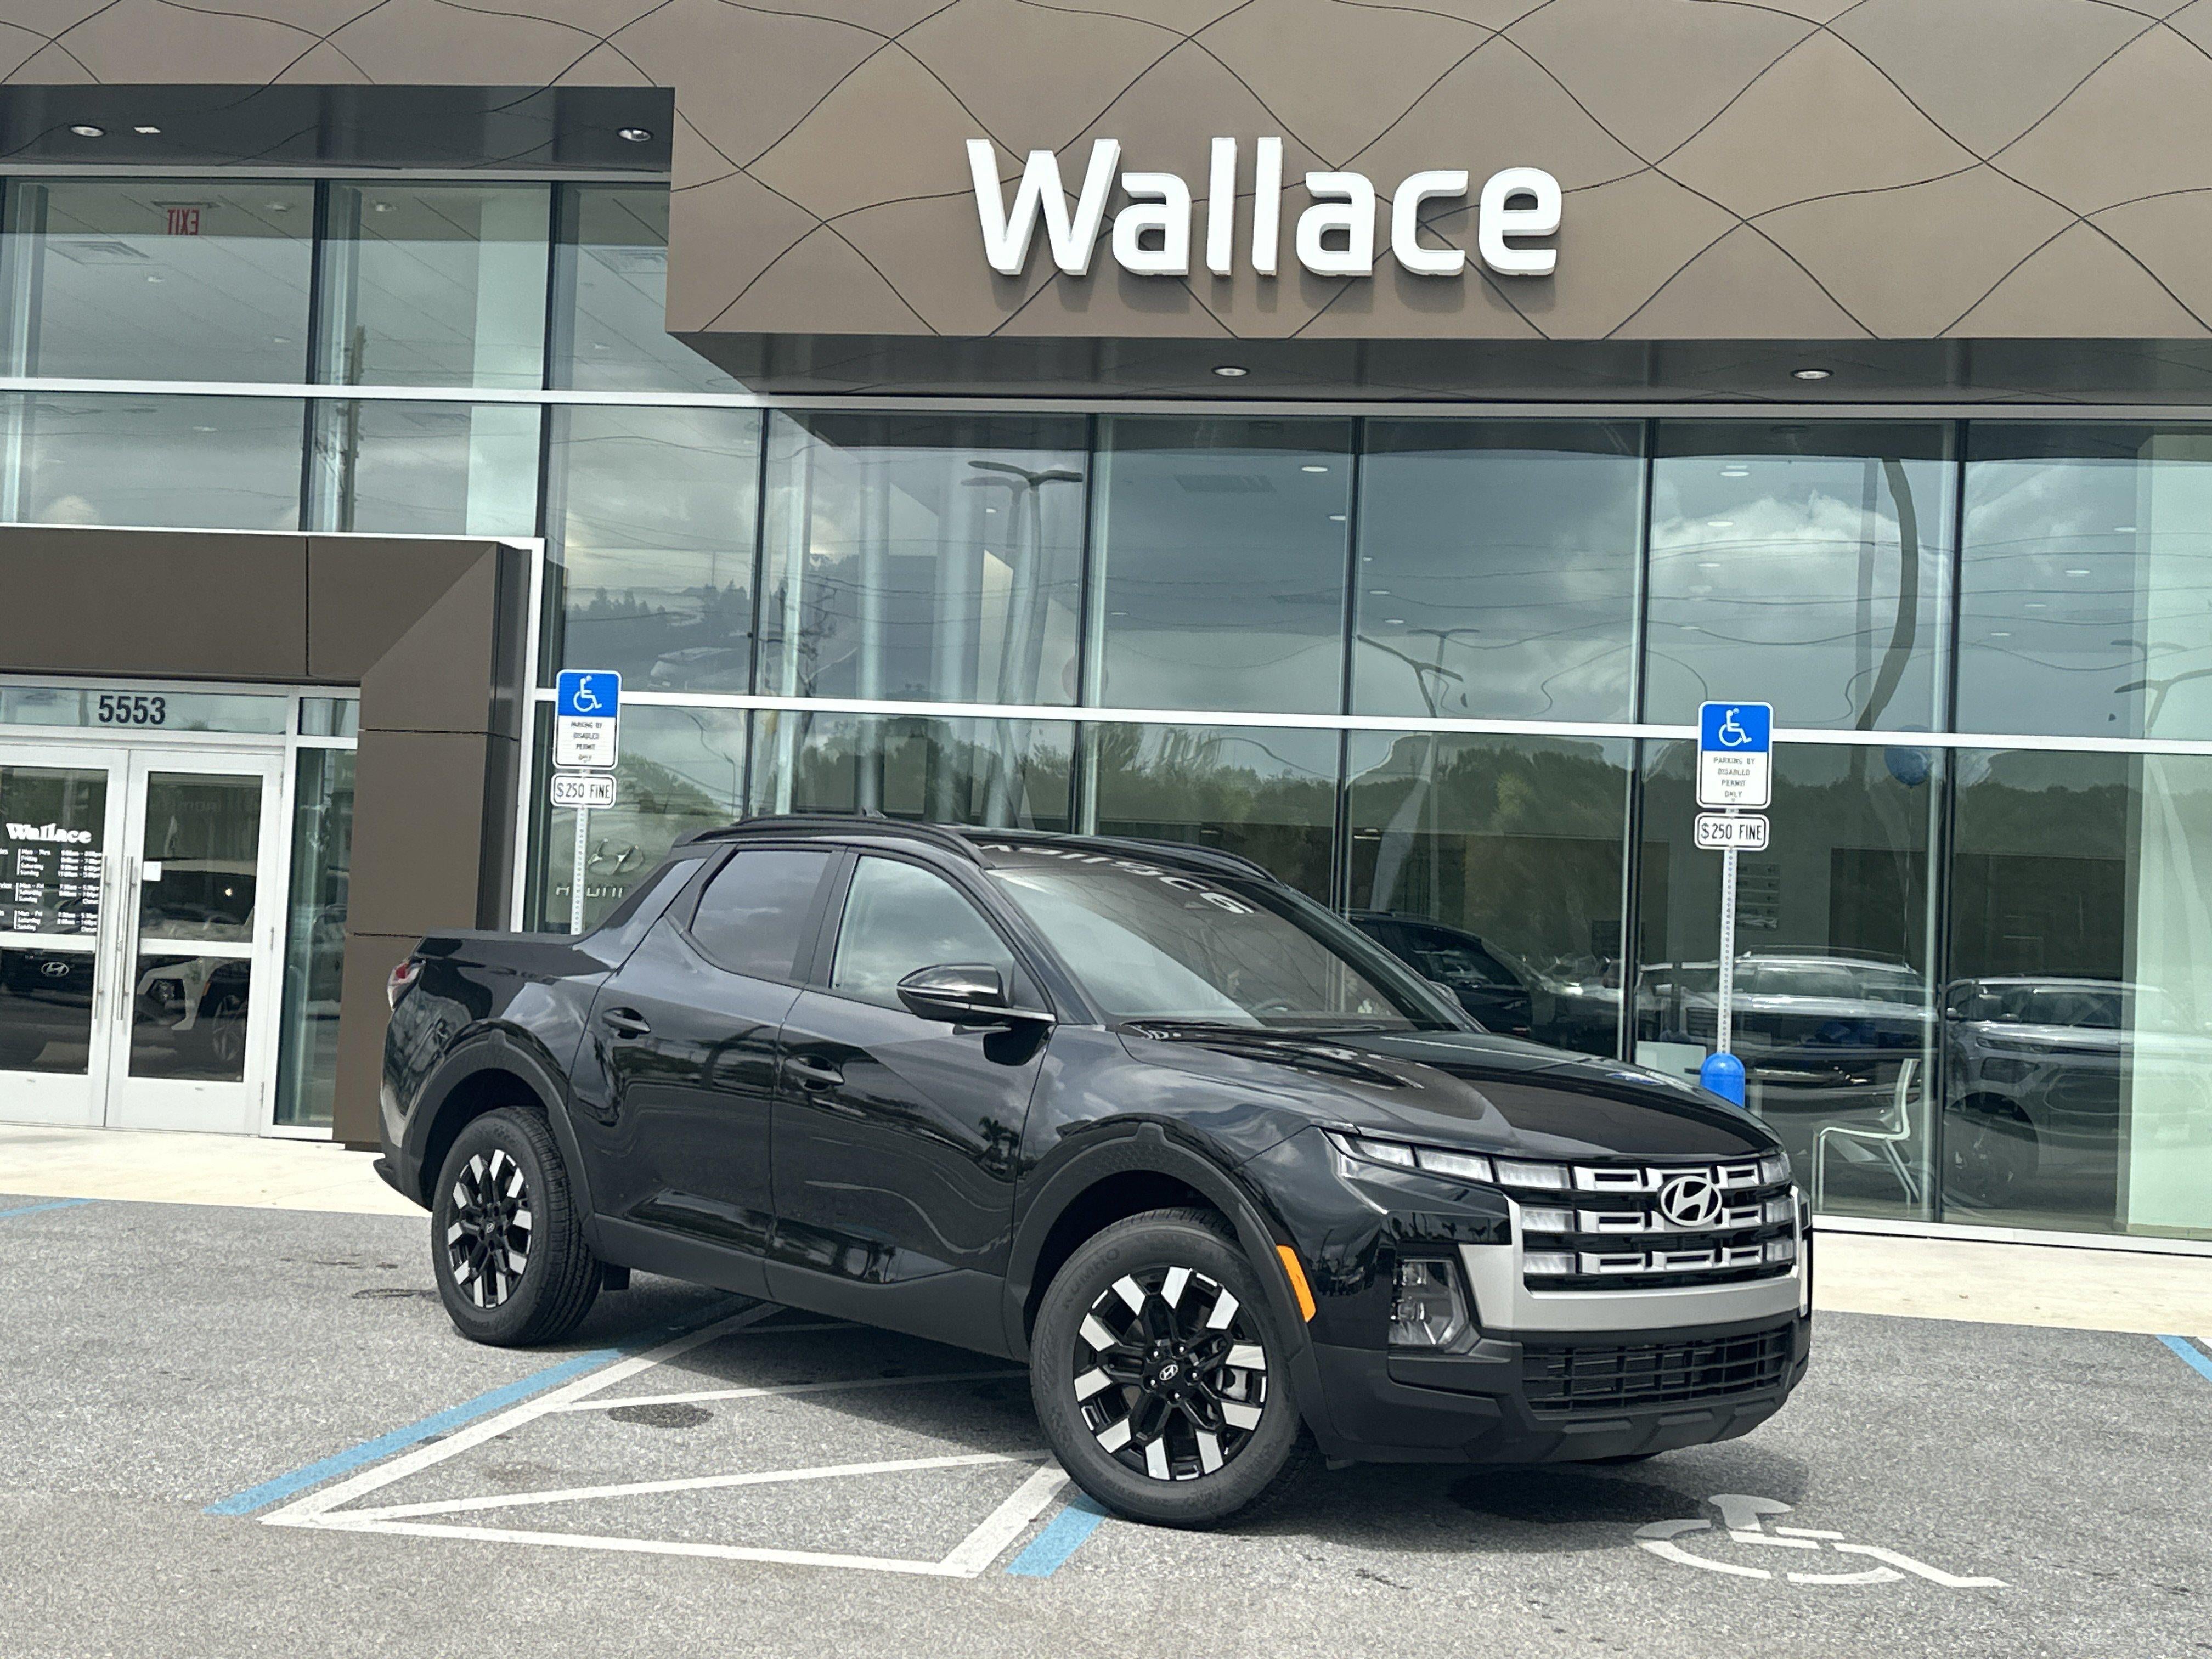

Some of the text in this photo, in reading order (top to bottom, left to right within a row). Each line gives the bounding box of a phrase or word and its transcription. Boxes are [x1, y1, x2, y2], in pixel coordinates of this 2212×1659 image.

[966, 136, 1562, 276] Wallace
[98, 694, 166, 725] 5553
[556, 782, 610, 799] $250 FINE
[6, 823, 92, 843] Wallace
[1701, 822, 1762, 840] $250 FINE
